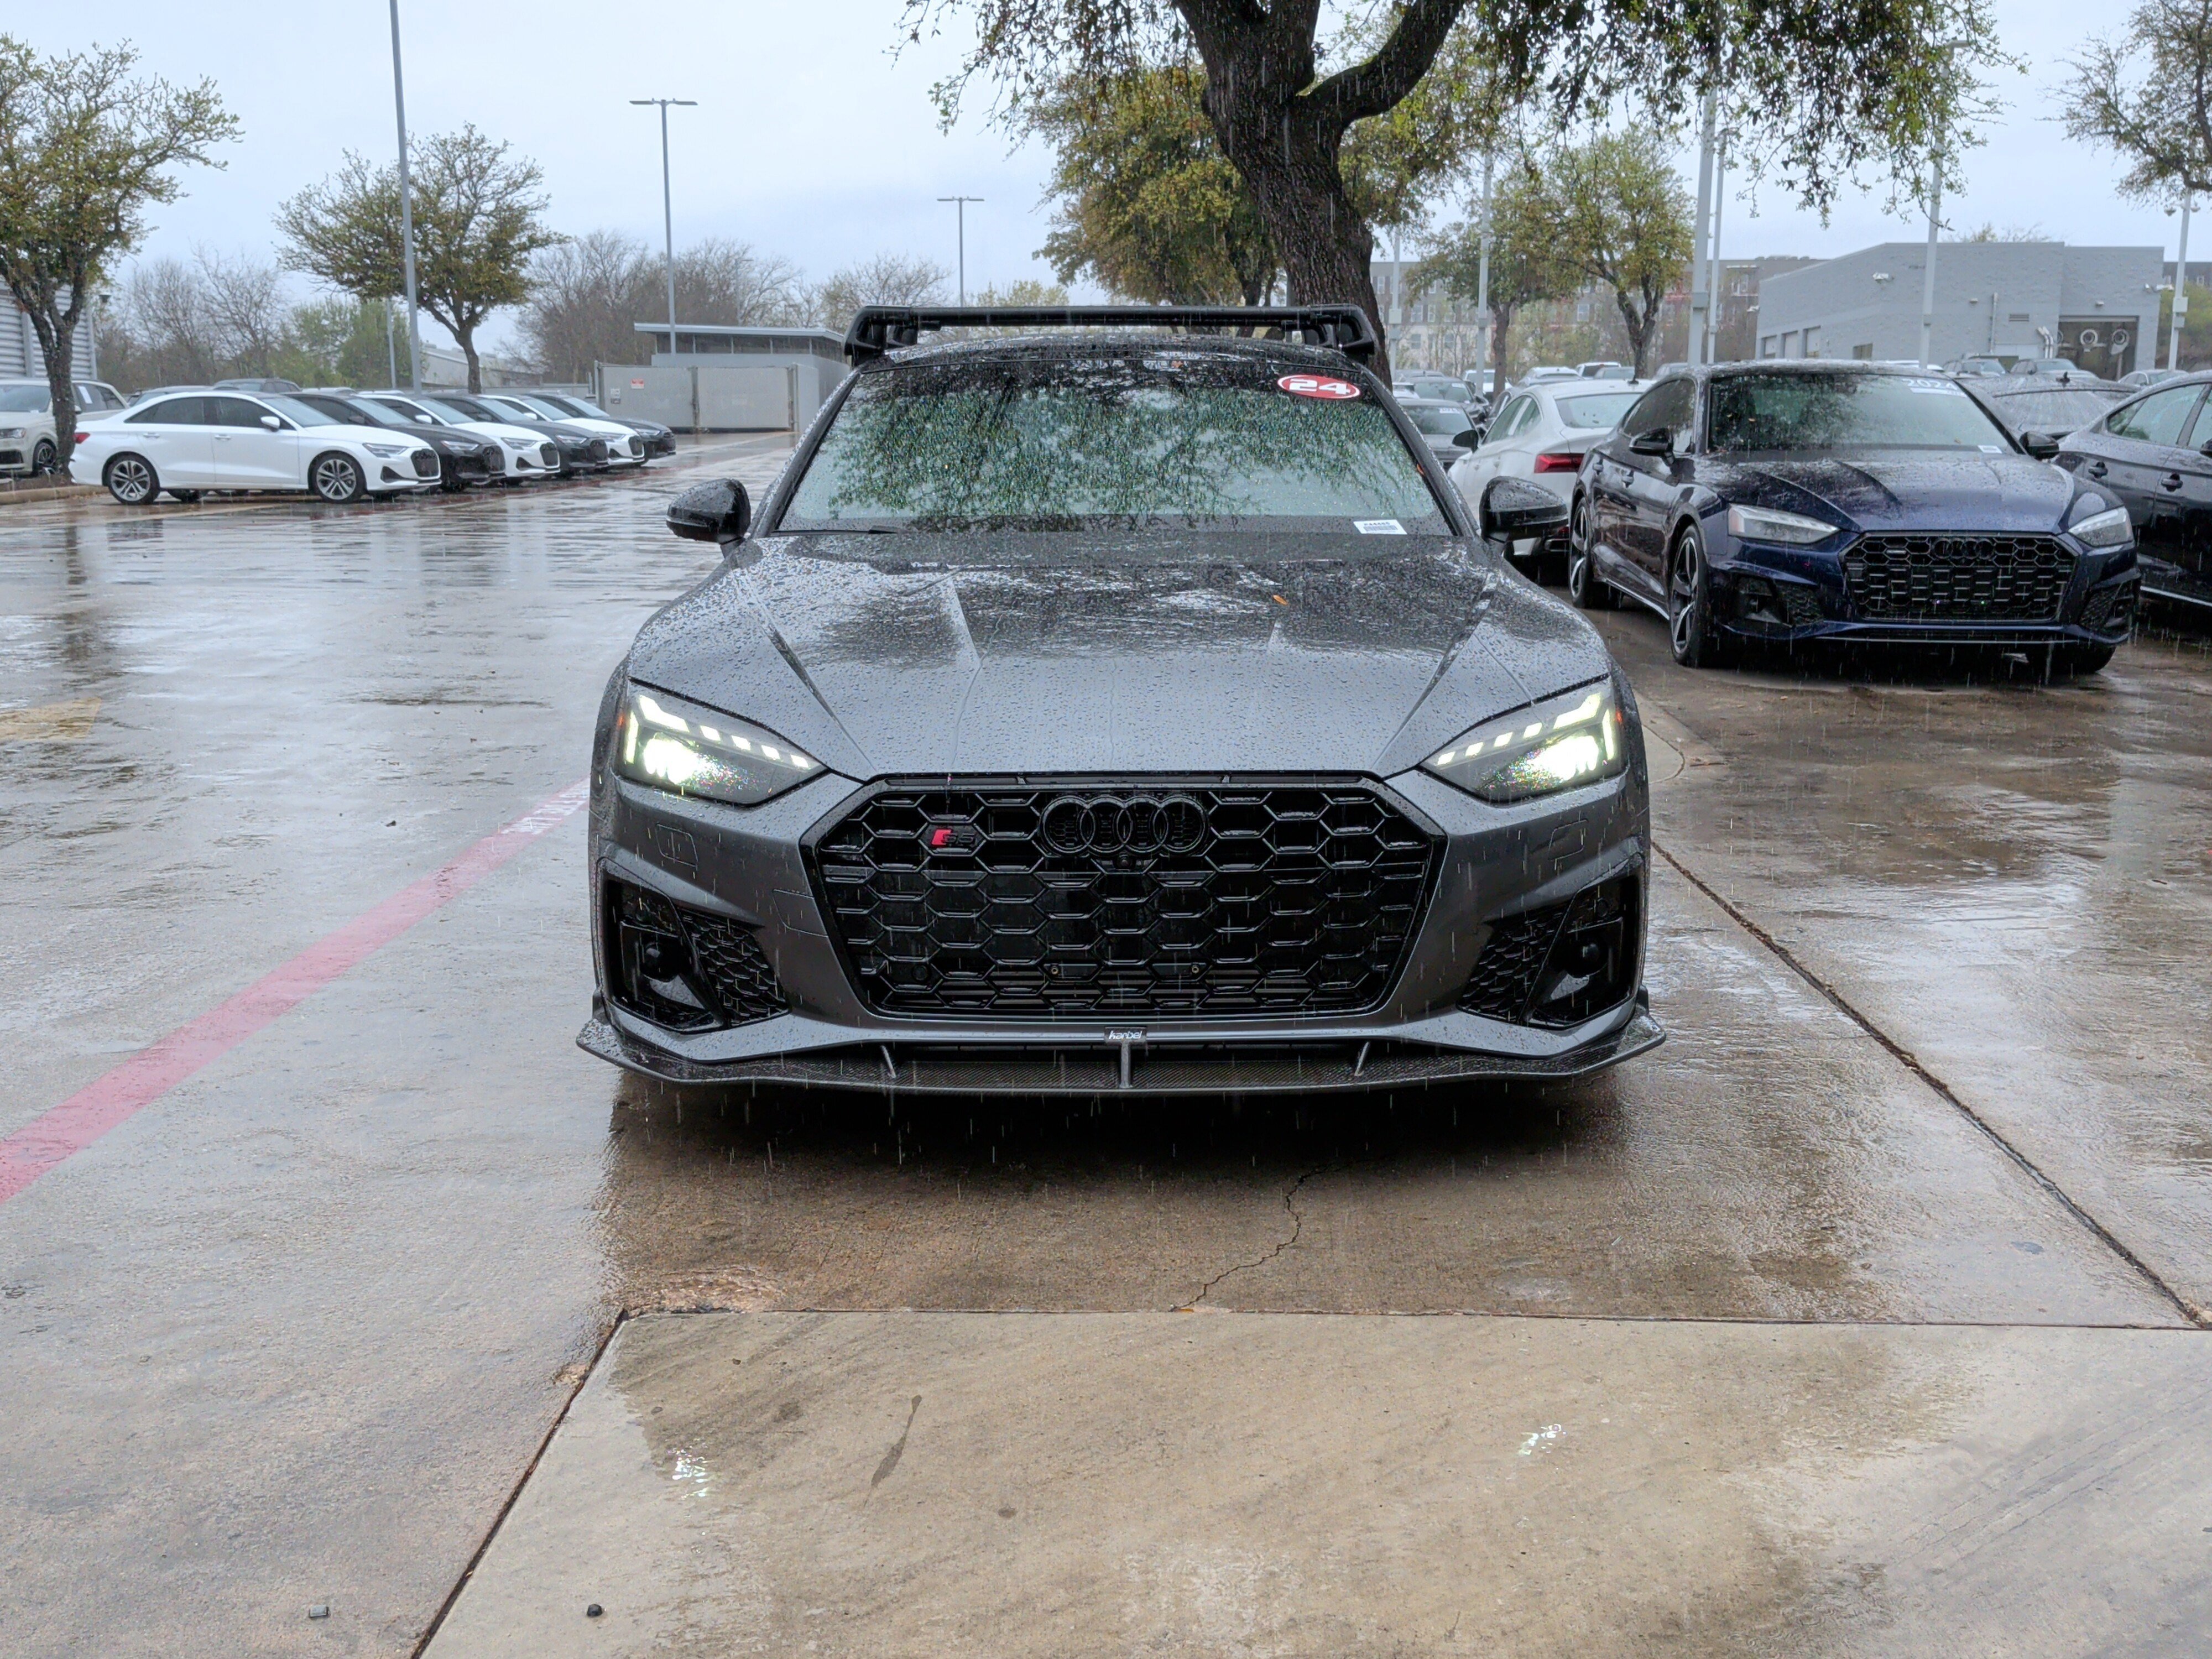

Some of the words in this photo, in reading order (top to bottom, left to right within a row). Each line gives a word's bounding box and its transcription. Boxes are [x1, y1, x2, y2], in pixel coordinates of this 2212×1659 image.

[1289, 379, 1350, 394] 24
[942, 832, 975, 844] S5
[1109, 1030, 1142, 1040] karbel
